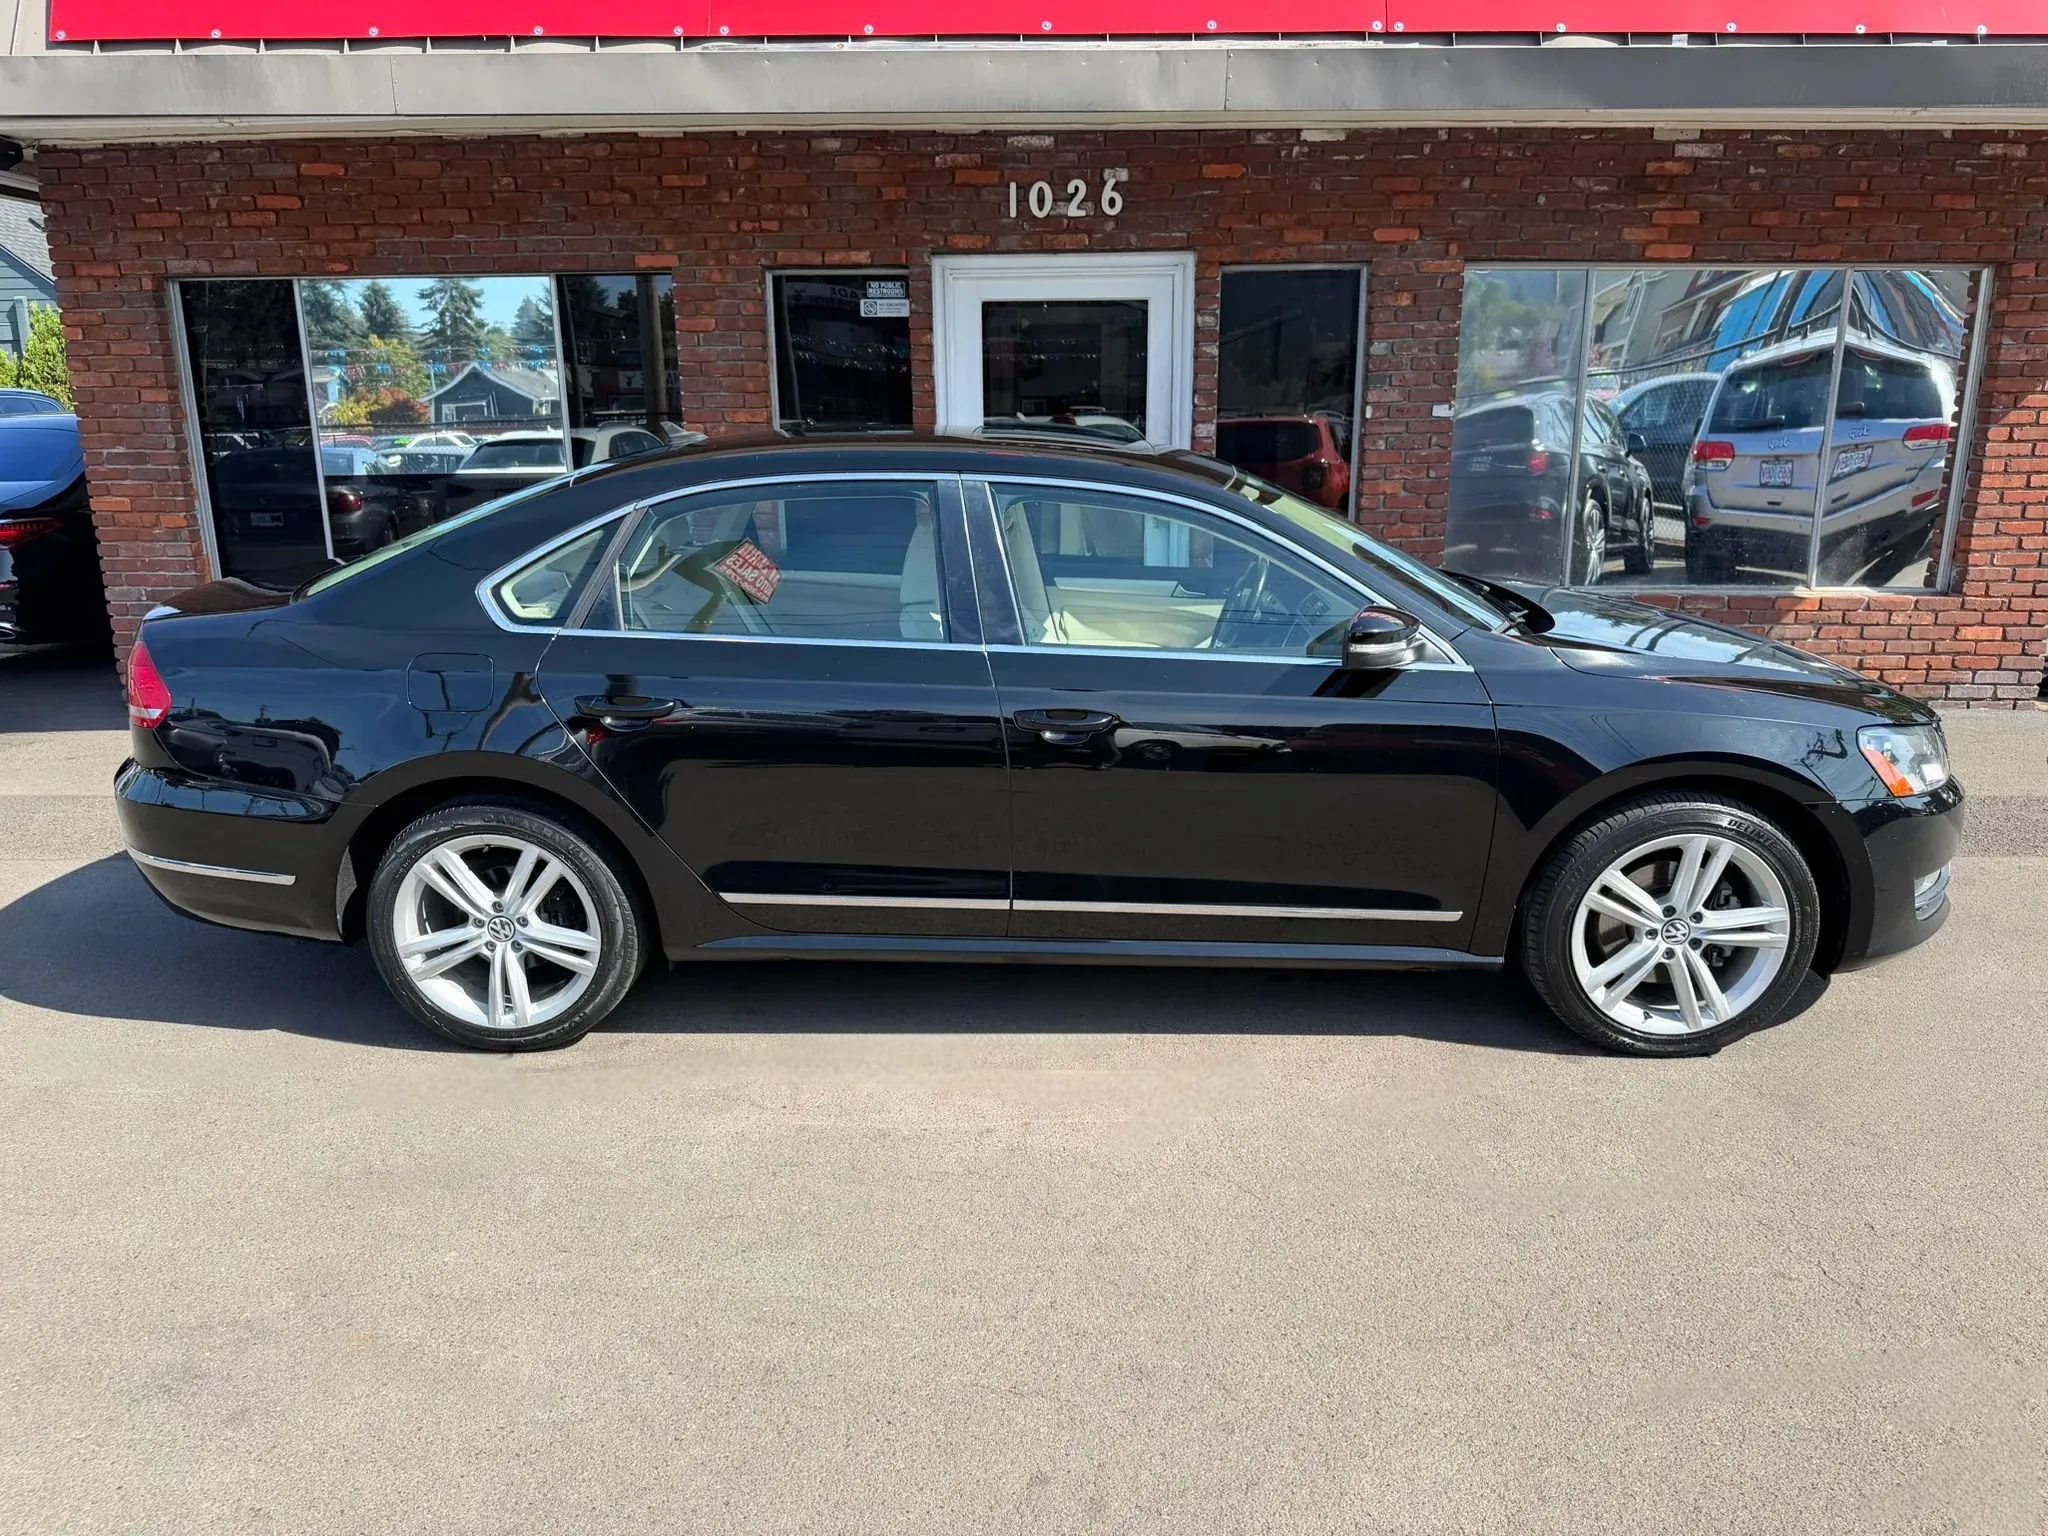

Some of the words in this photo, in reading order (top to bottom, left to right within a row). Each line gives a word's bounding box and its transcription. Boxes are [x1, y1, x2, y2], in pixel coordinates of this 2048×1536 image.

[1009, 178, 1123, 218] 1026
[870, 281, 880, 289] NO
[881, 281, 903, 289] PUBLIC
